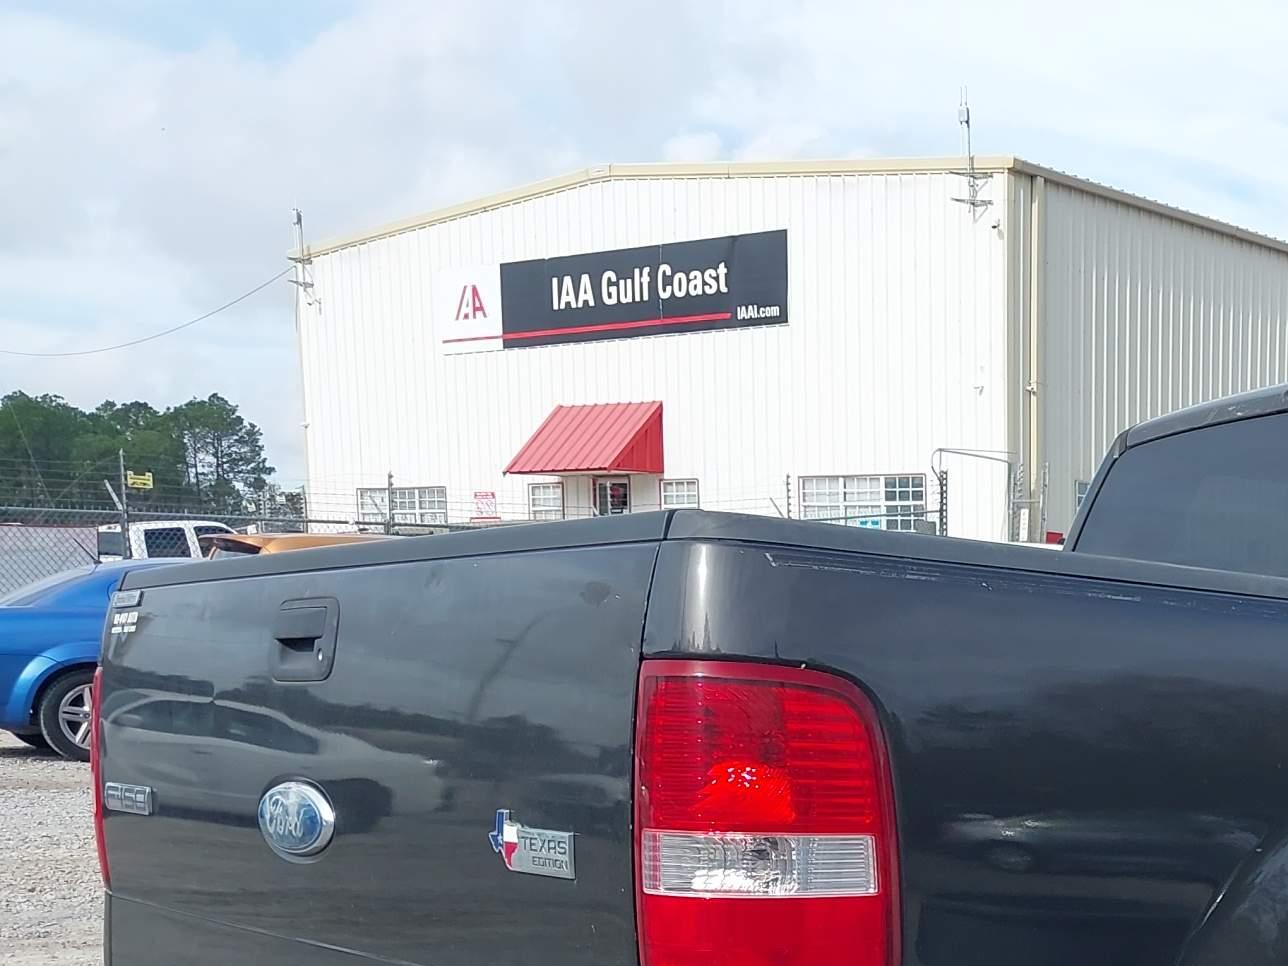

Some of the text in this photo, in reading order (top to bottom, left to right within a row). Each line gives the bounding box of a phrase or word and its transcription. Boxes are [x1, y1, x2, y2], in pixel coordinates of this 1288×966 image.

[552, 261, 729, 310] IAA Gulf Coast
[520, 836, 567, 855] TEXAS
[531, 855, 569, 871] EDITION
